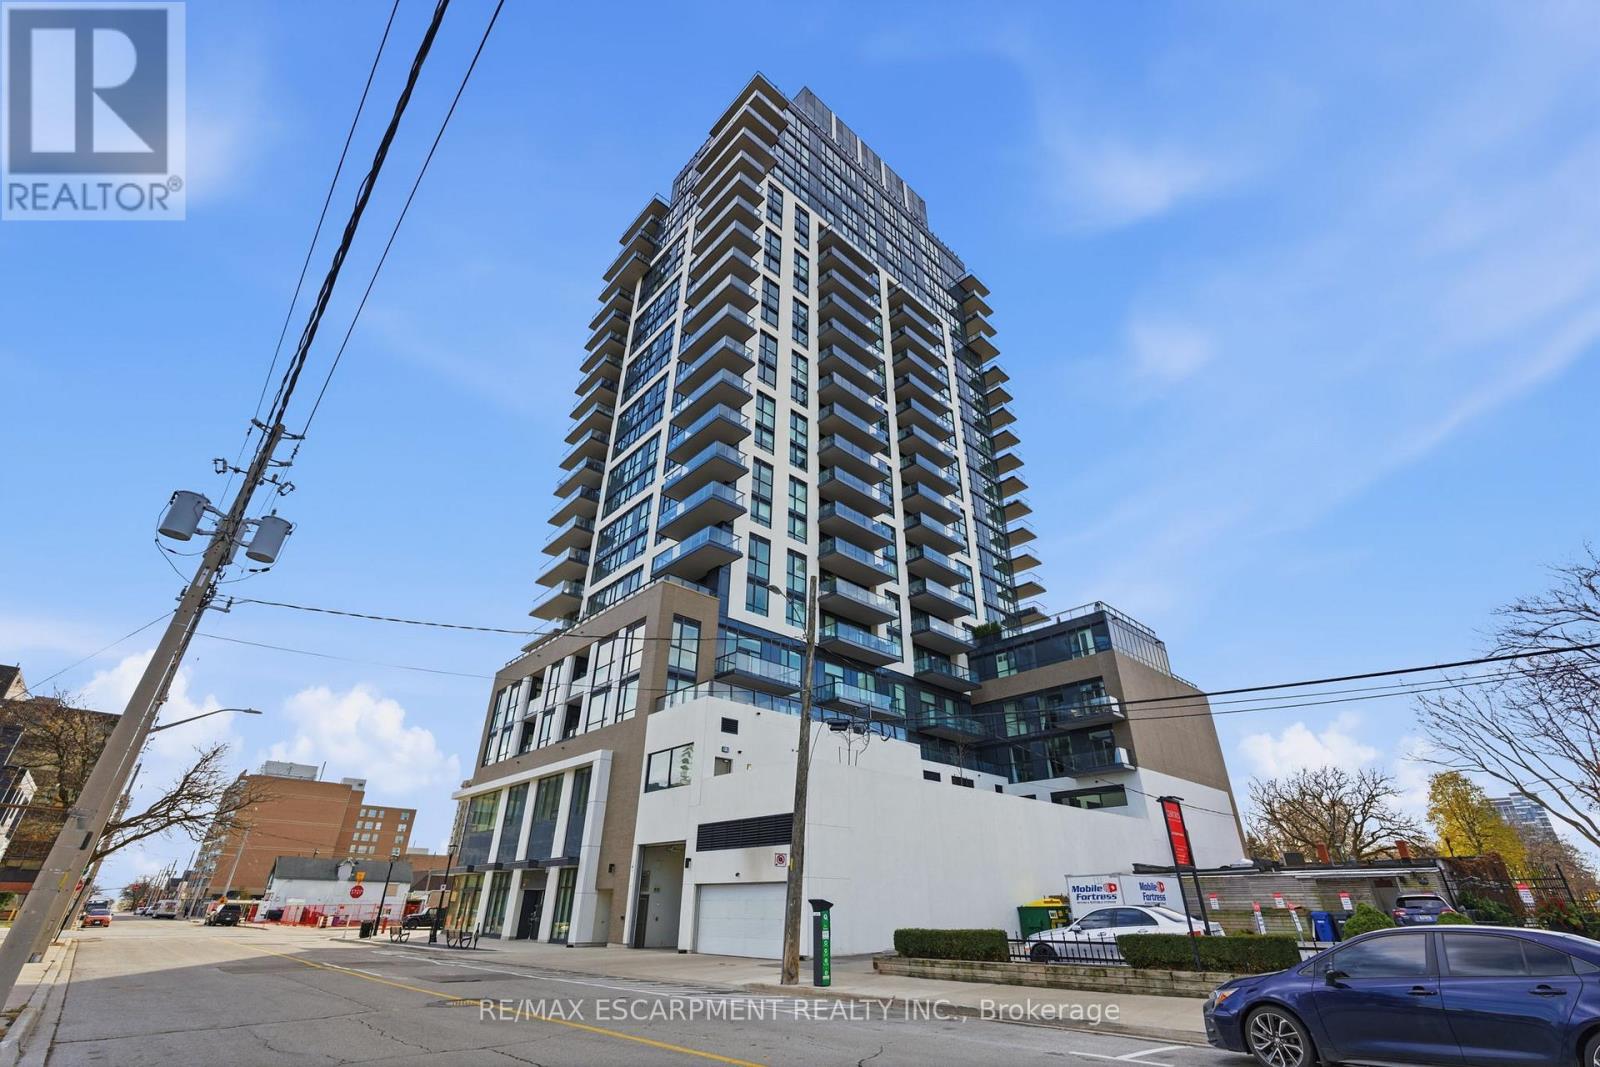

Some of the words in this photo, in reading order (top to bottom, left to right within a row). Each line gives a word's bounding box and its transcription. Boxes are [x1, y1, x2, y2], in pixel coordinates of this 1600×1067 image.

[1072, 885, 1103, 893] Mobile
[1139, 882, 1157, 891] Mobile
[1076, 893, 1117, 901] Fortress
[1142, 892, 1167, 901] Fortress
